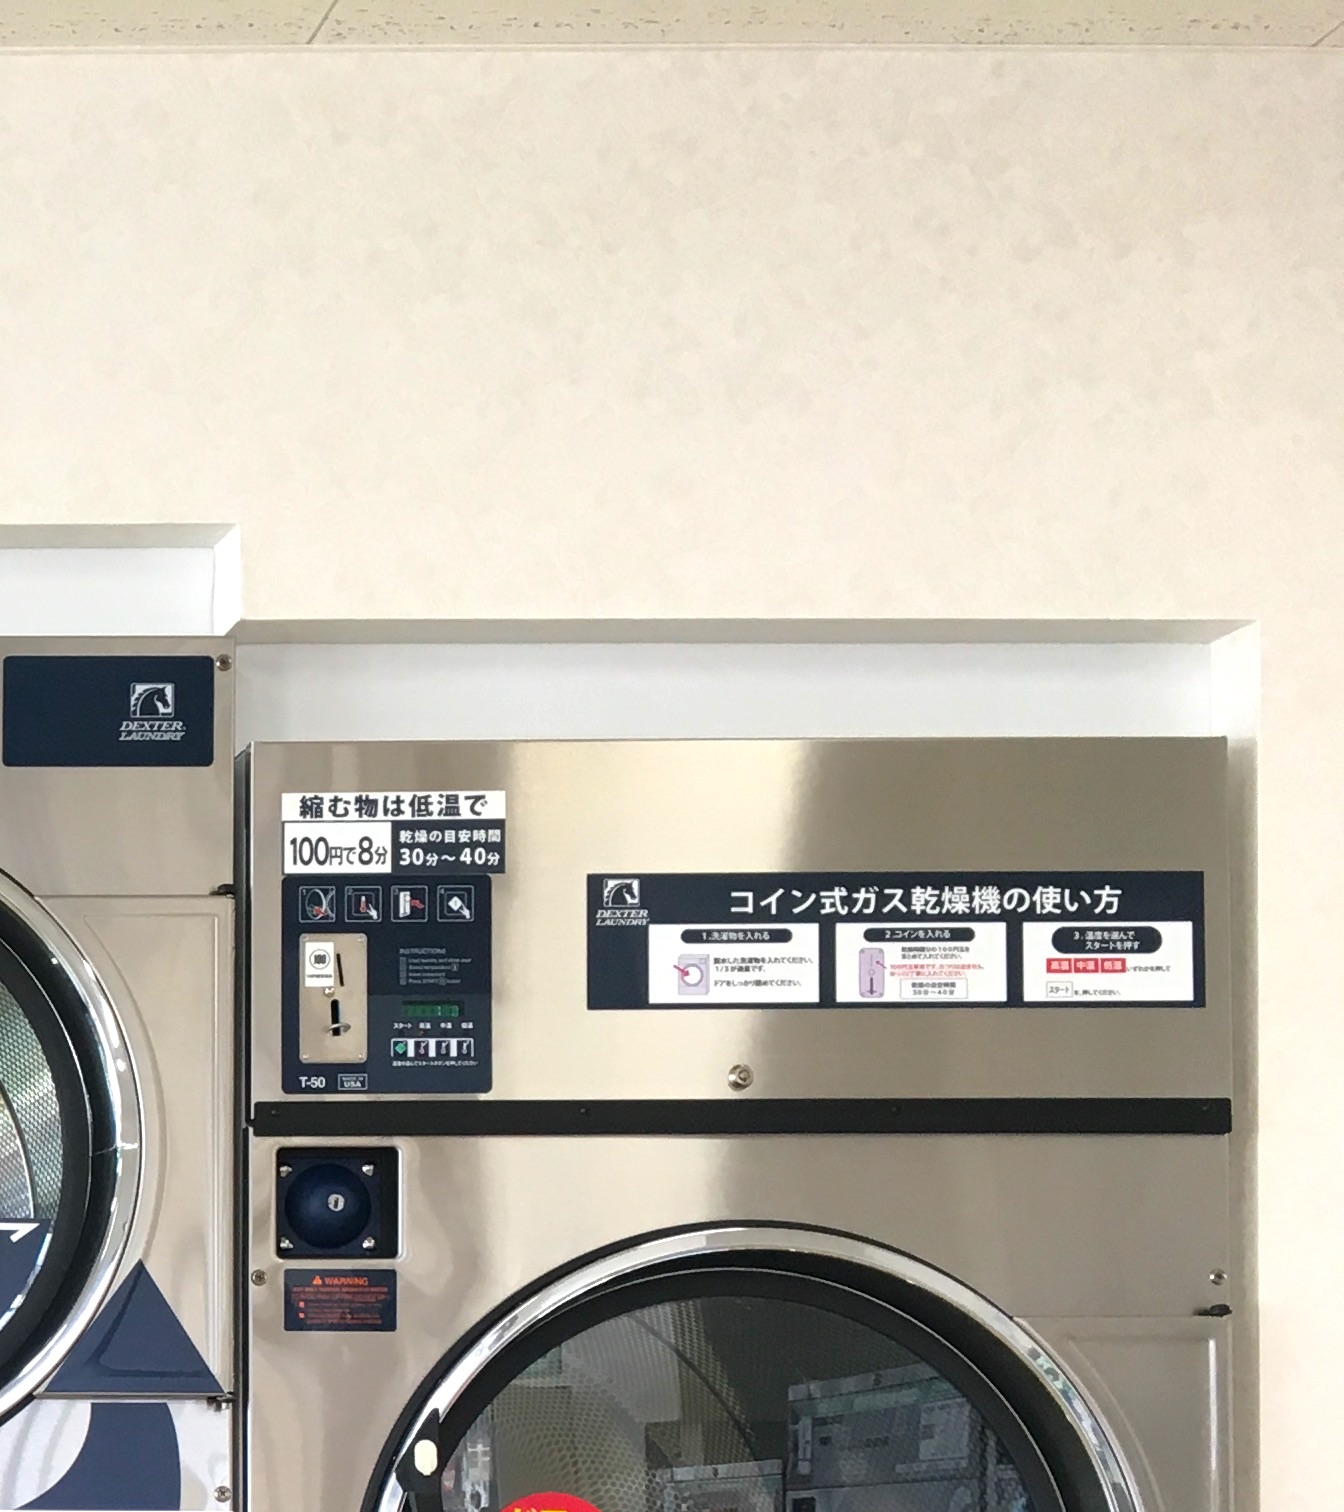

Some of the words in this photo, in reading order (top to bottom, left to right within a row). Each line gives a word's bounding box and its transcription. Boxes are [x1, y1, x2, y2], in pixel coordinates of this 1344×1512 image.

[120, 721, 184, 731] DEXTER
[119, 731, 185, 740] LAUNDRY
[299, 793, 488, 819] 縮む物は低温で
[399, 830, 500, 844] 乾燥の目安時間
[289, 836, 388, 866] 100円で8分
[399, 848, 500, 866] 30分～40分
[730, 886, 1122, 915] コイン式ガス乾燥機の使い方
[299, 1077, 325, 1088] T-50
